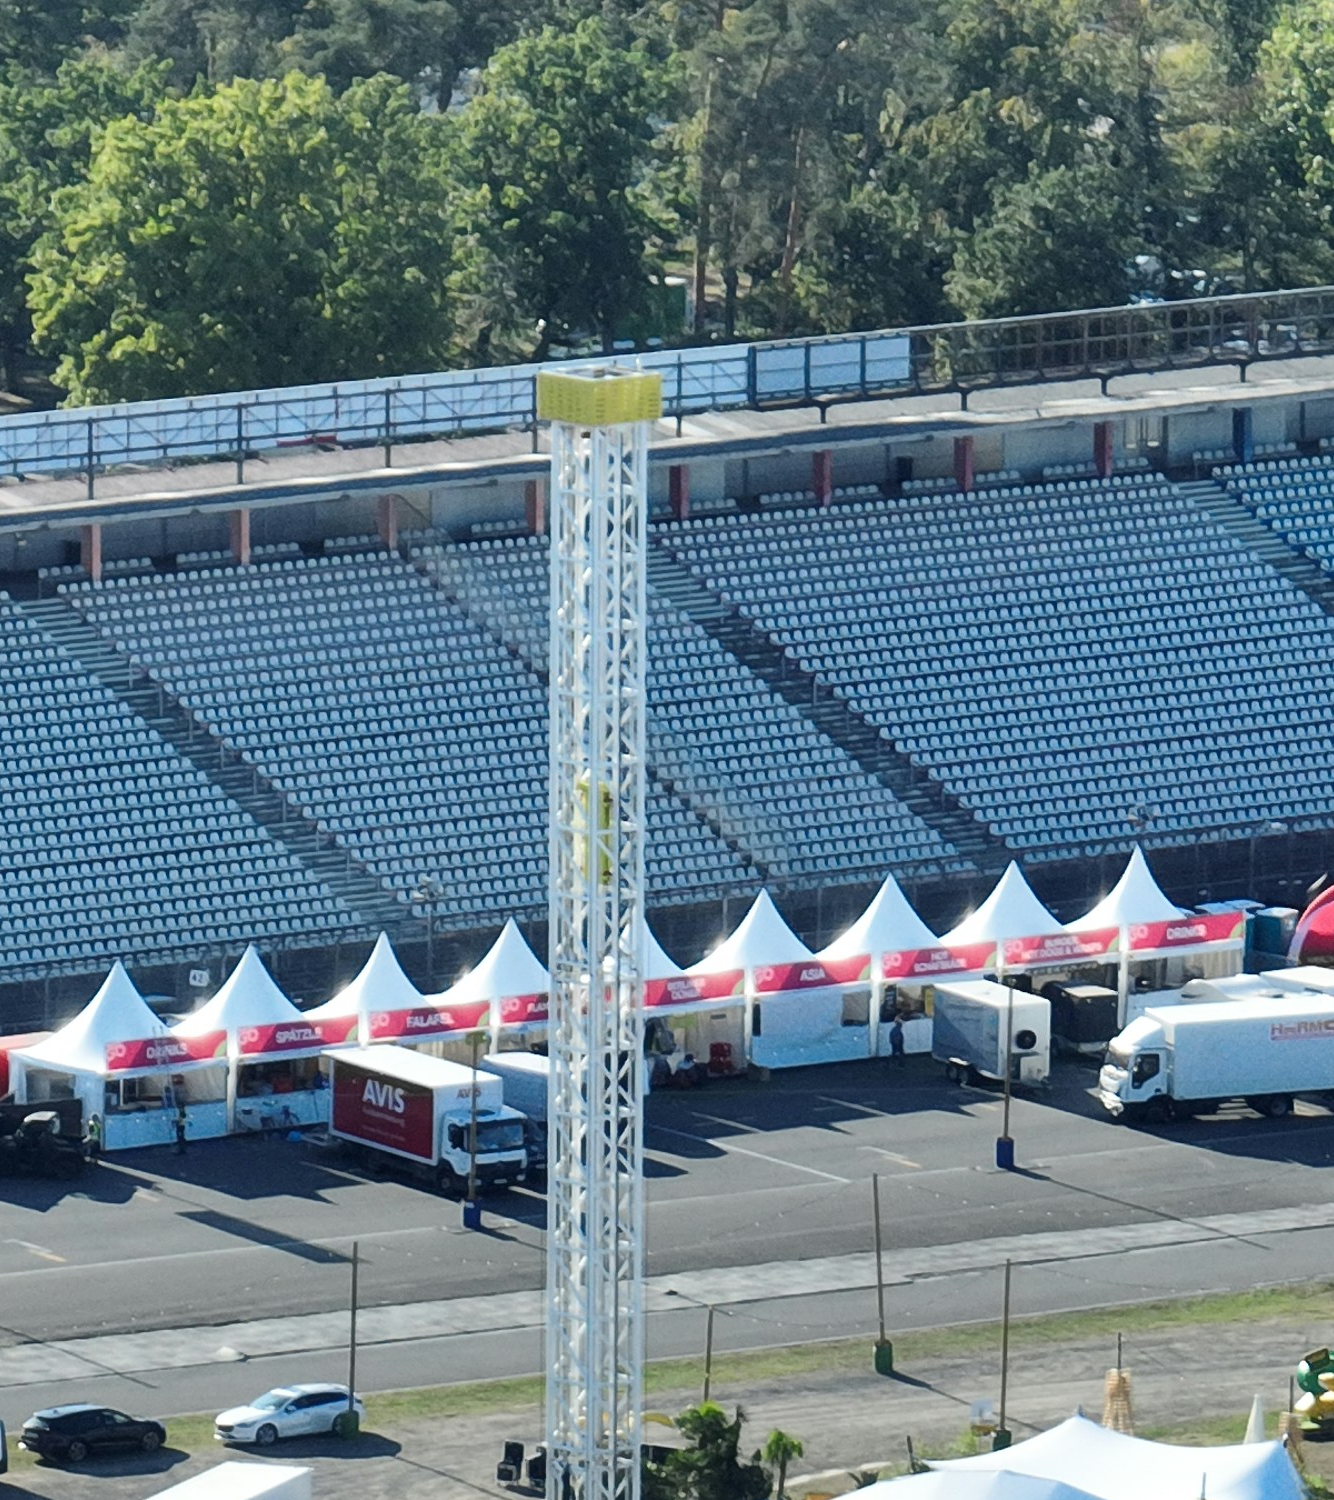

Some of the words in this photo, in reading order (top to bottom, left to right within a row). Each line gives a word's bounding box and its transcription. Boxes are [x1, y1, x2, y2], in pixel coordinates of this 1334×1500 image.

[799, 967, 827, 982] ASIA
[362, 1078, 405, 1114] AVIS
[457, 1086, 482, 1099] AVS
